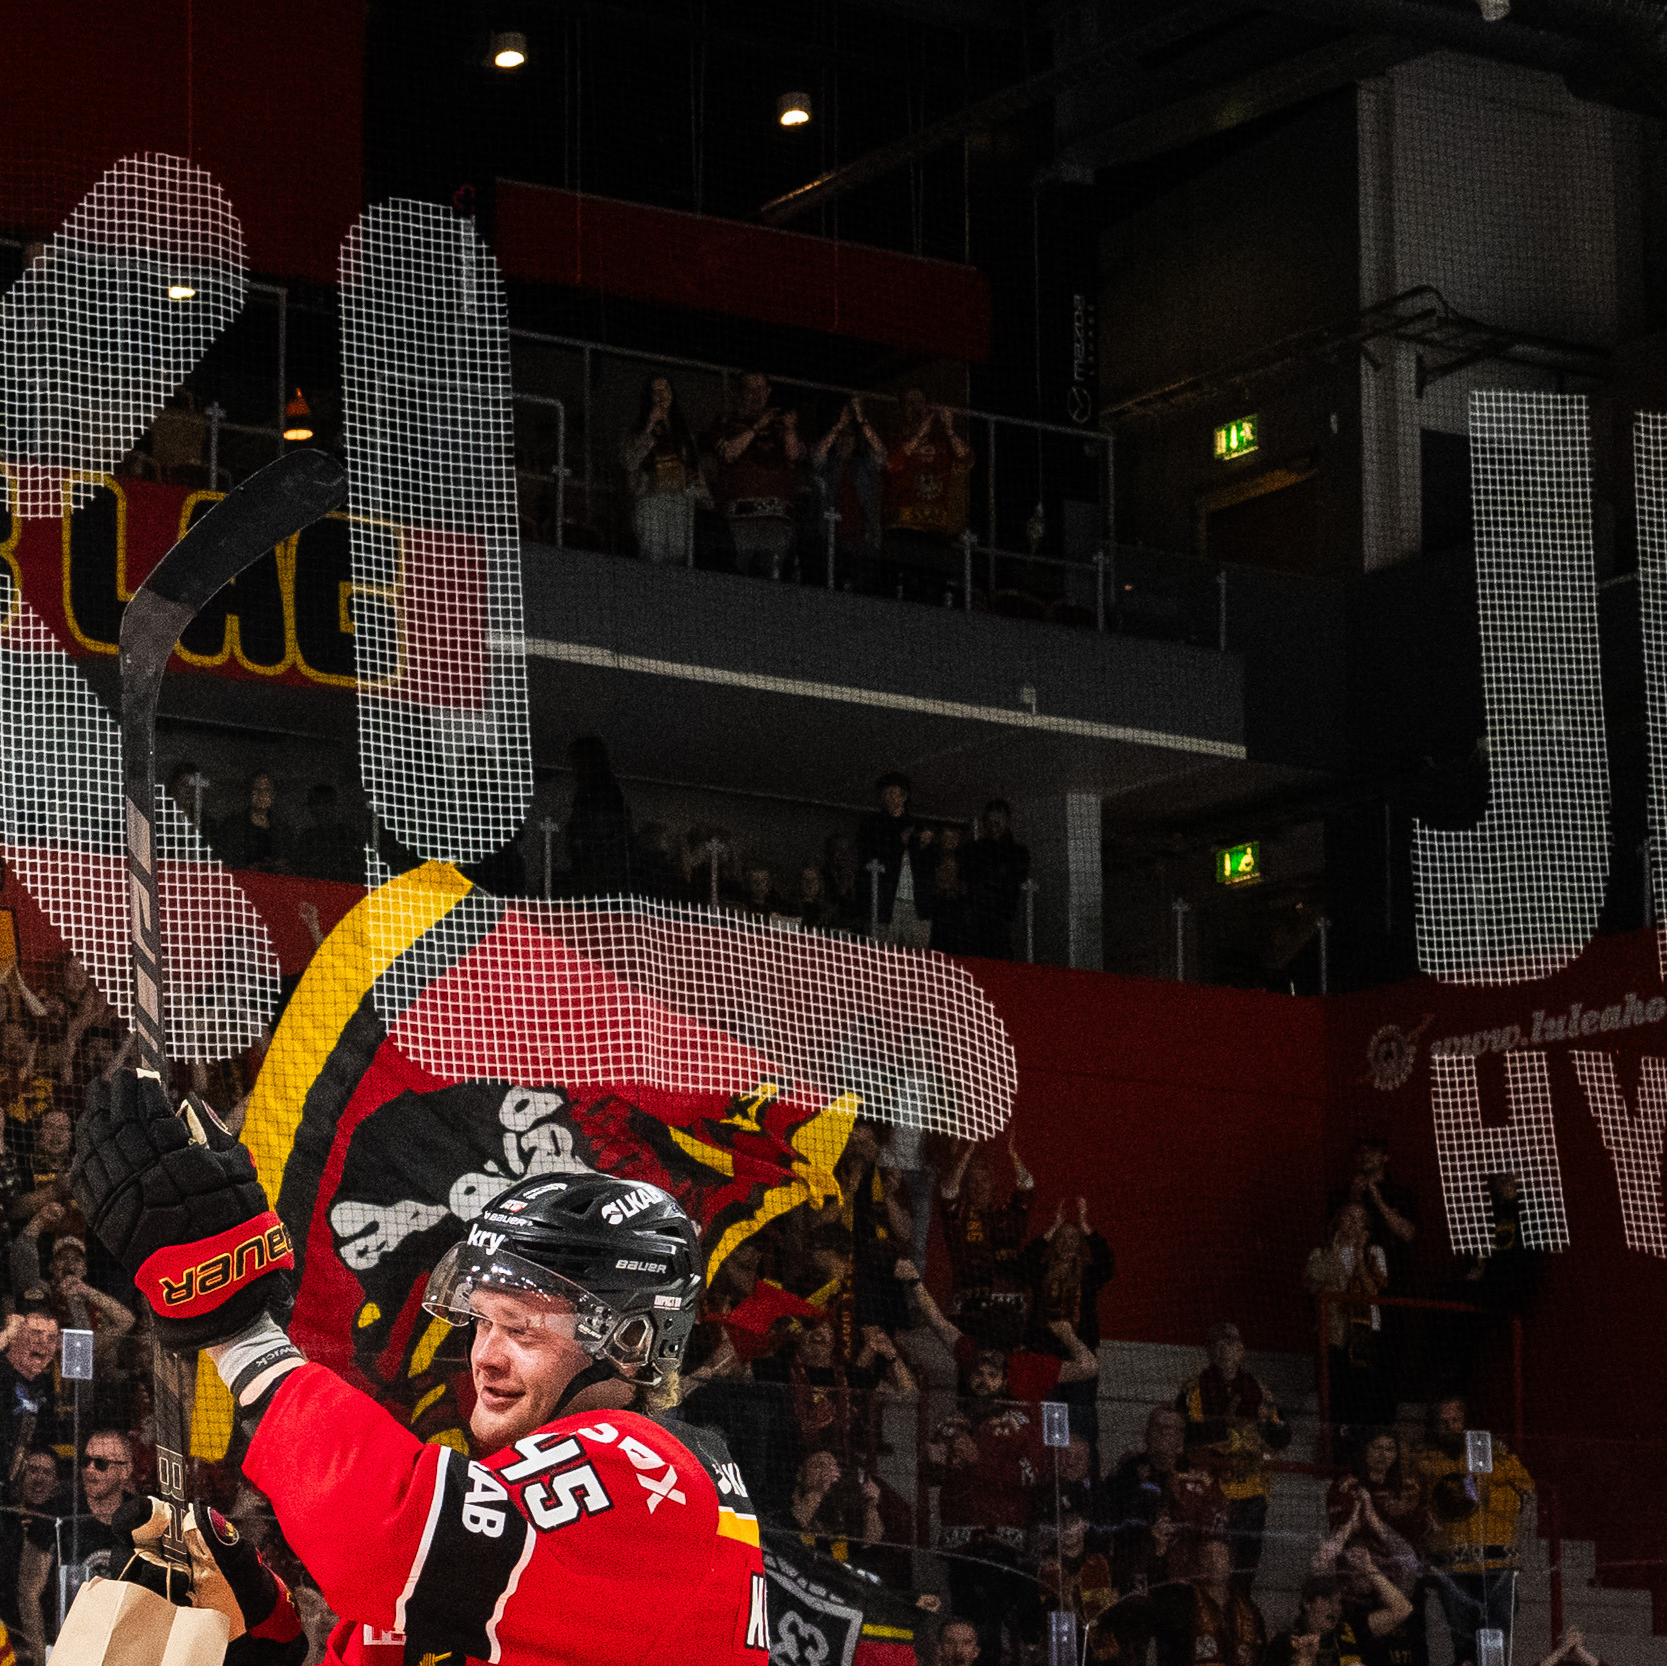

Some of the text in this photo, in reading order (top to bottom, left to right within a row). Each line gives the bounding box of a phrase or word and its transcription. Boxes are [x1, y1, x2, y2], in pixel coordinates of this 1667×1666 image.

[467, 1223, 505, 1256] kry
[616, 1259, 667, 1274] BAUER
[495, 1433, 615, 1534] 45
